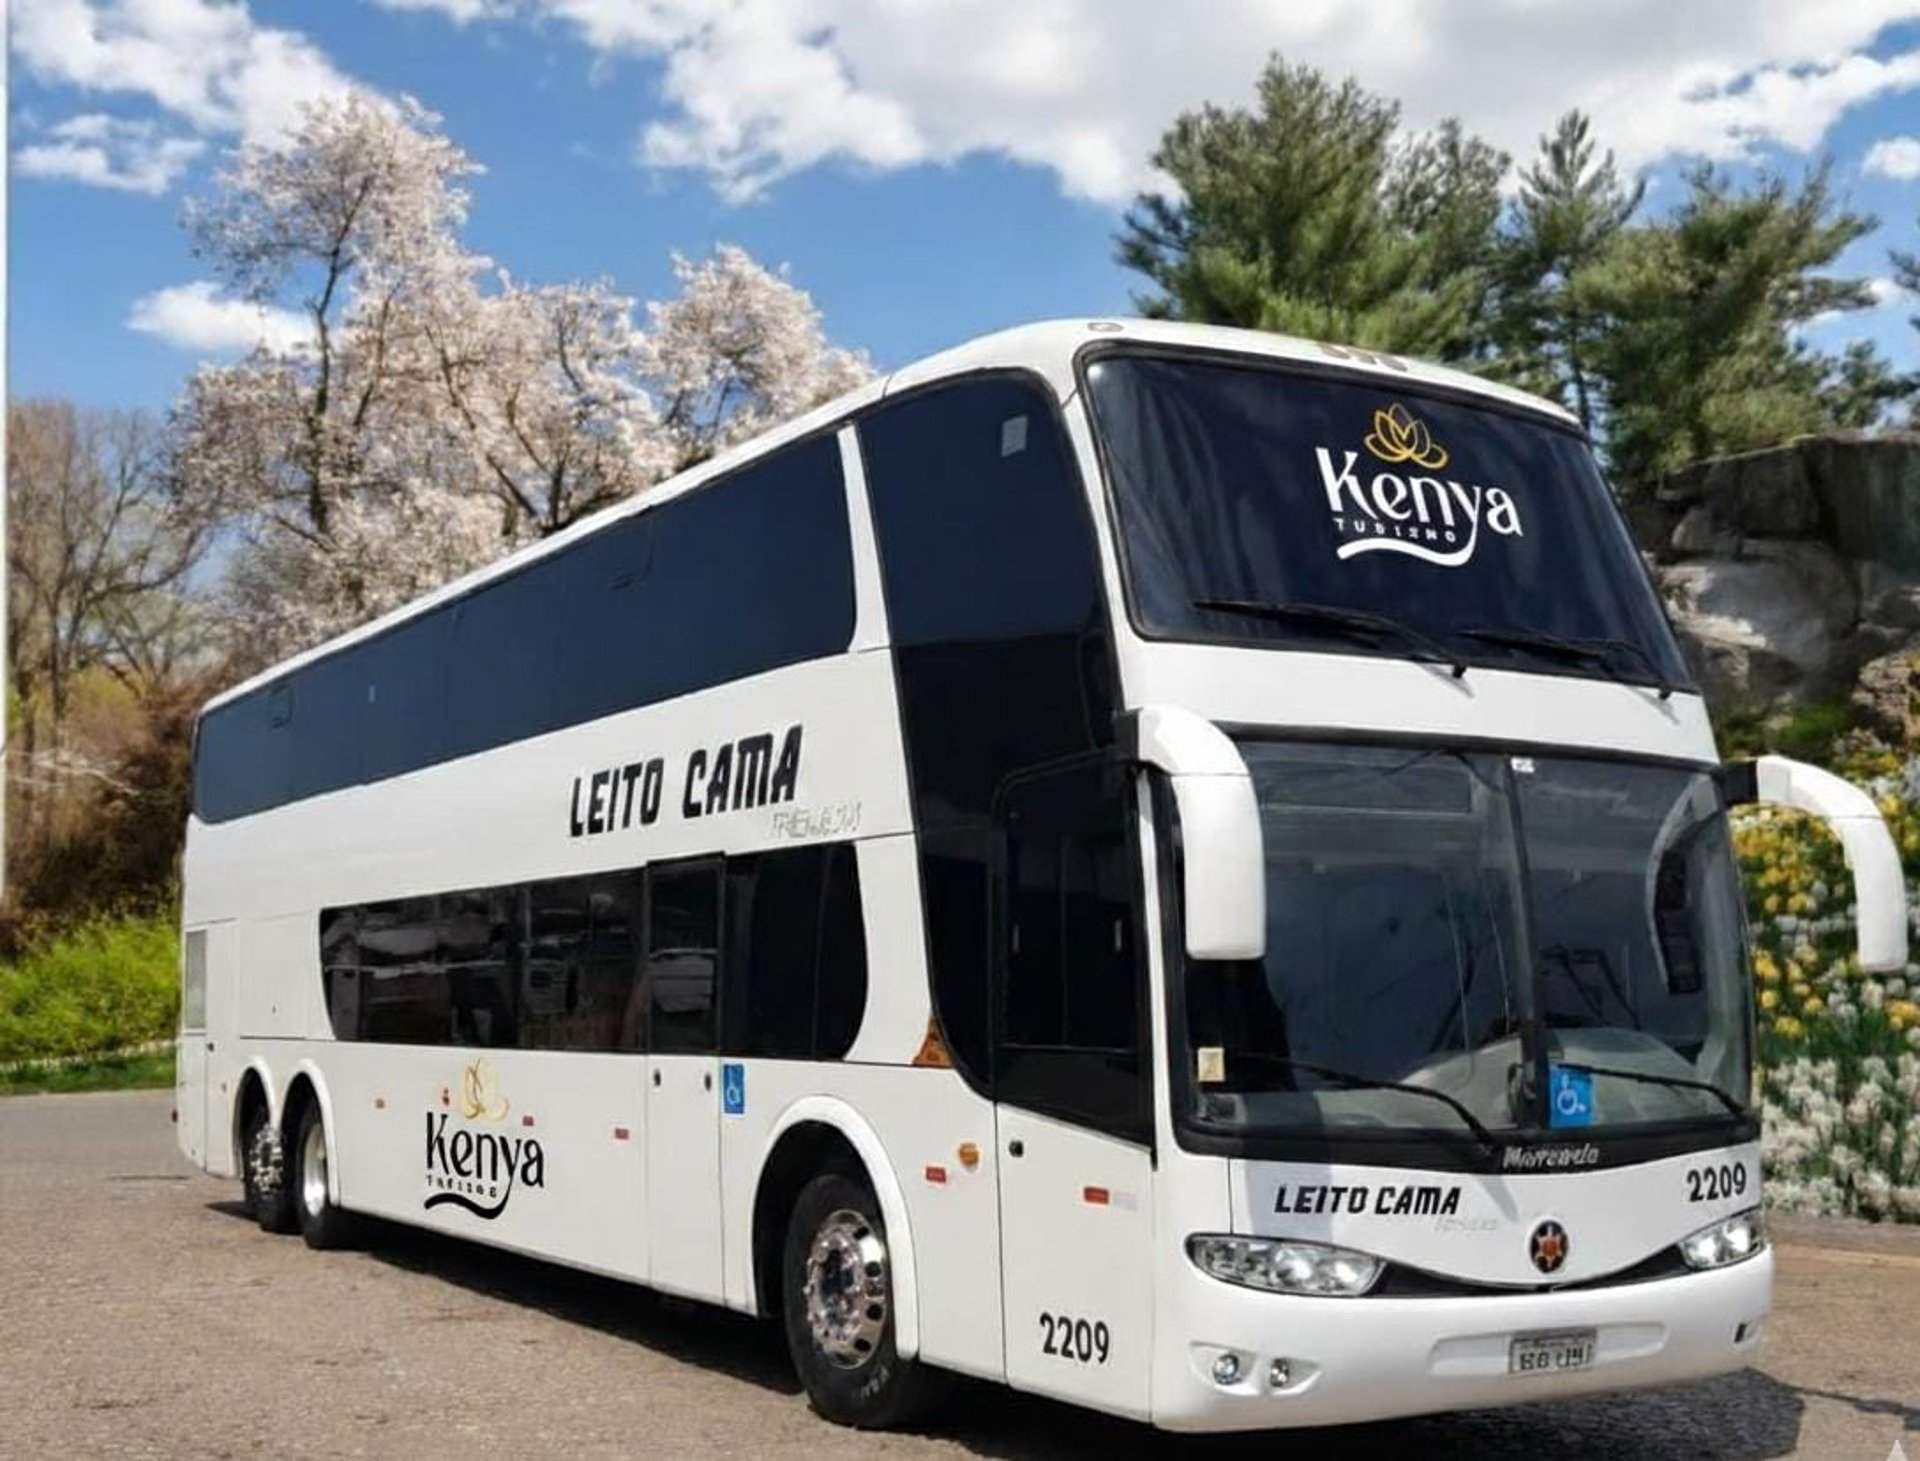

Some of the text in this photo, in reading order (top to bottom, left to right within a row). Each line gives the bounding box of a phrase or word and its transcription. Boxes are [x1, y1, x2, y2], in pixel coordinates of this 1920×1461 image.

[1315, 447, 1523, 566] Kenya
[570, 724, 803, 837] LEITO CAMA
[424, 1111, 544, 1219] Kenya
[1274, 1186, 1461, 1215] LEITO CAMA
[1686, 1161, 1747, 1202] 2209
[1039, 1312, 1109, 1364] 2209
